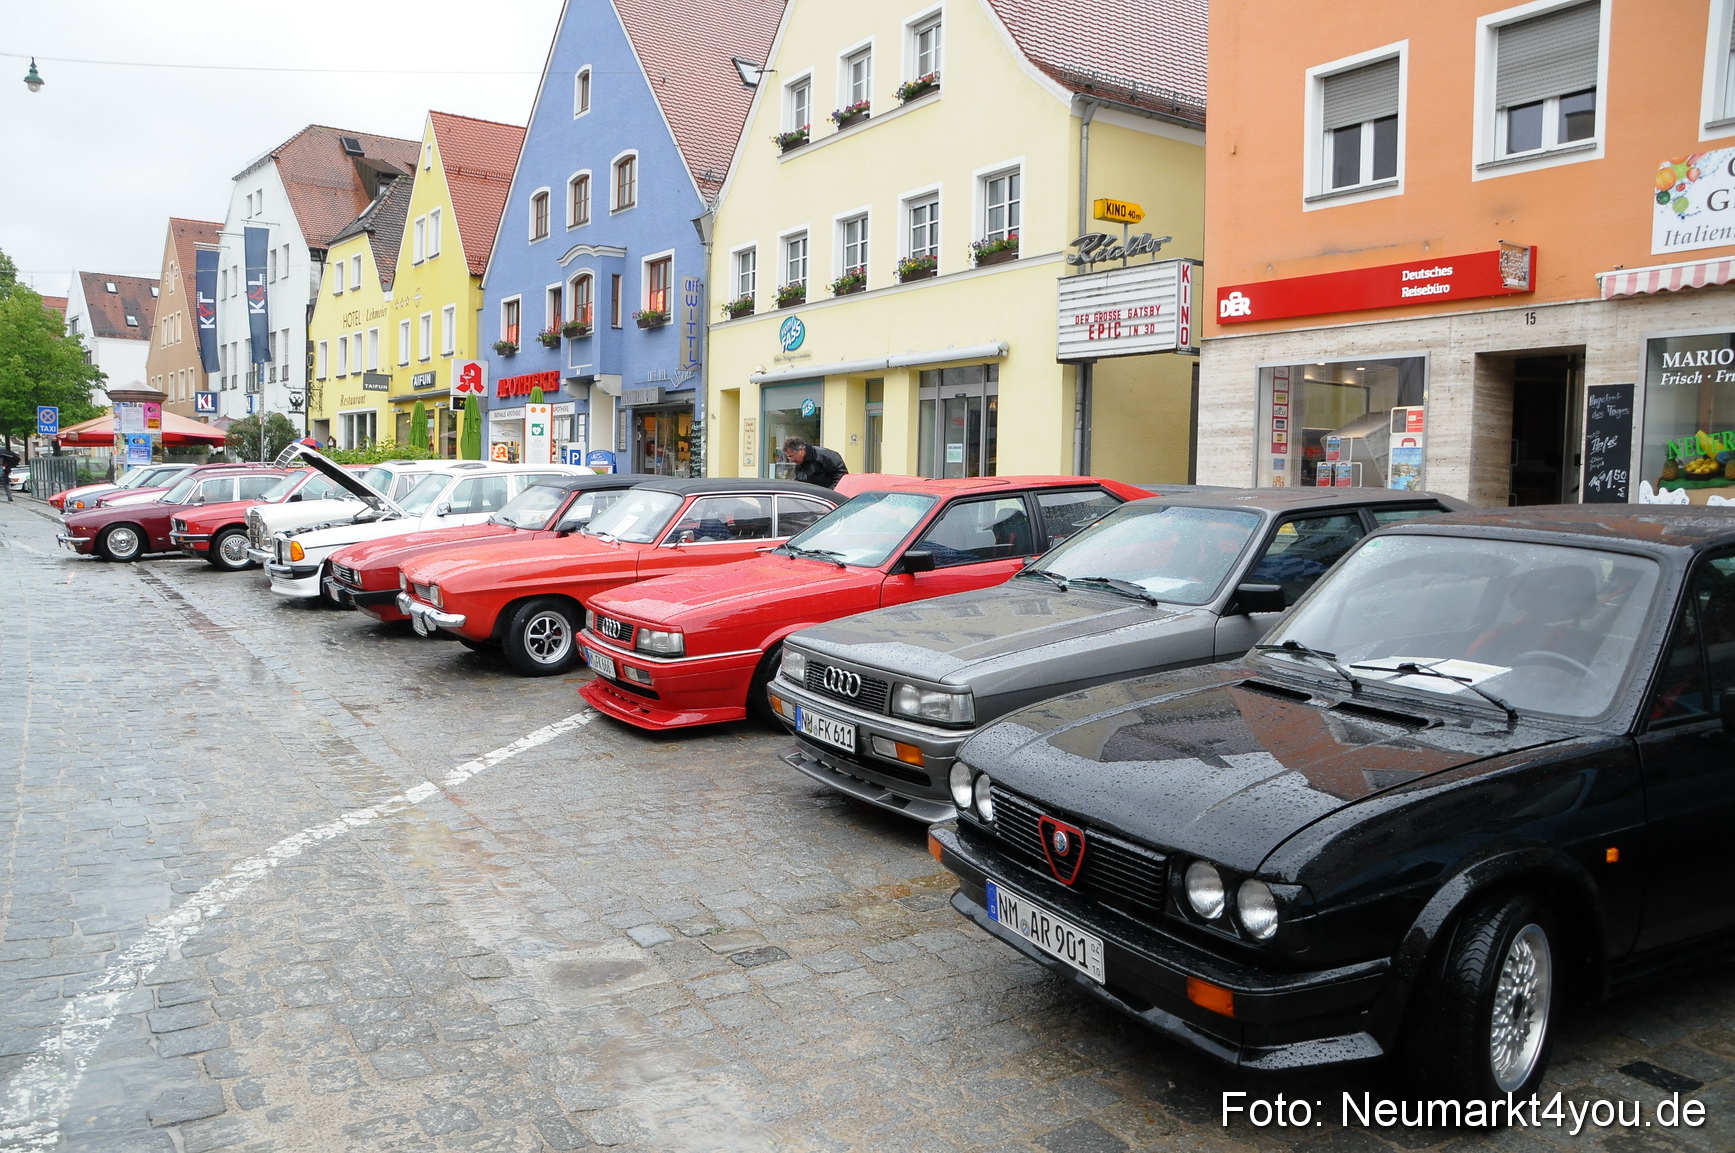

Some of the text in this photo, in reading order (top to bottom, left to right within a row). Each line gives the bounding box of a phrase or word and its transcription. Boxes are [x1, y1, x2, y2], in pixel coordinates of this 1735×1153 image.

[1106, 202, 1127, 218] KINO
[1707, 188, 1735, 211] G
[1664, 225, 1735, 247] Italien
[1066, 233, 1172, 266] Rialto
[1402, 266, 1453, 281] Deutsches
[248, 273, 266, 313] K&L
[1402, 284, 1450, 298] Reisebüro
[199, 291, 215, 328] K&L
[1075, 305, 1161, 325] DER GROSSE GATSBY
[1181, 264, 1190, 346] KINO
[1220, 293, 1251, 317] DER
[343, 310, 361, 328] HOTEL
[686, 294, 698, 363] WITTL
[1525, 312, 1536, 326] 15
[781, 320, 801, 353] FASS
[1088, 322, 1155, 340] EPIC IN 3D
[1662, 348, 1734, 369] MARIO
[496, 370, 560, 398] APOTHEKE
[1660, 371, 1703, 386] Frisch
[1667, 430, 1735, 459] NEUER
[572, 452, 580, 465] P
[819, 718, 831, 741] FK
[833, 724, 853, 749] 611
[998, 892, 1089, 969] NM AR 901
